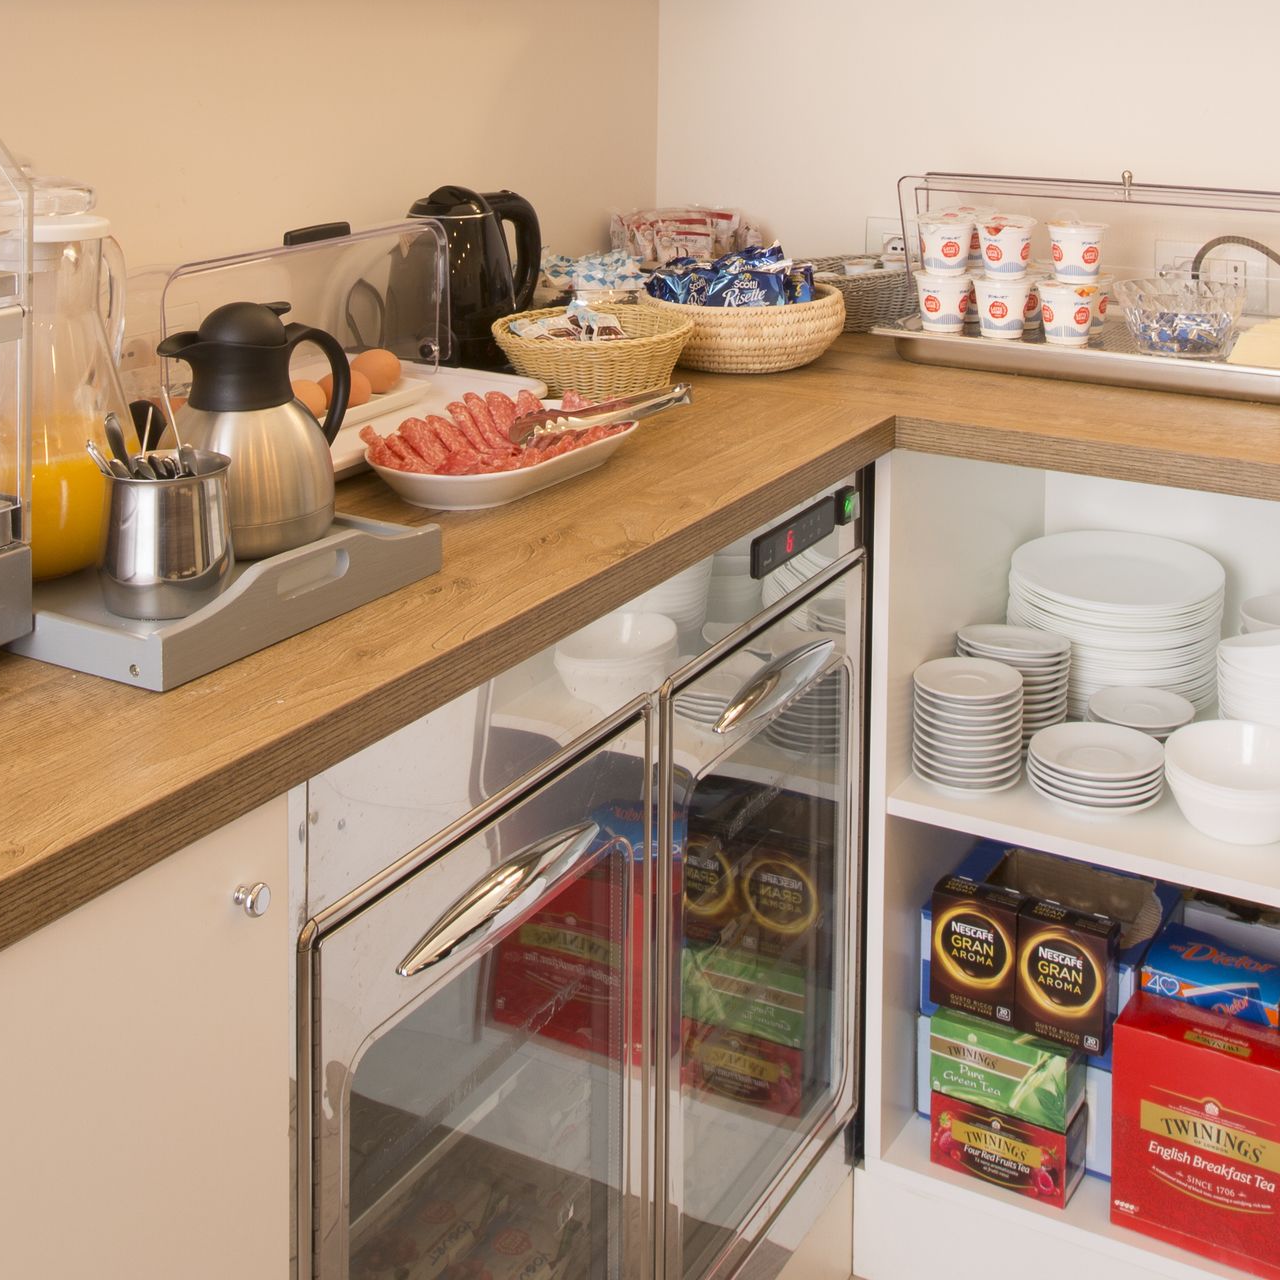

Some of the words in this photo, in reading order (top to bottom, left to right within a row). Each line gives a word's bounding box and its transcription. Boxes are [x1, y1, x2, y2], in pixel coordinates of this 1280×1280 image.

[722, 289, 766, 307] Risette
[785, 529, 795, 553] 6
[951, 935, 994, 957] GRAN
[951, 949, 994, 967] AROMA
[1180, 942, 1279, 974] Dietor
[1038, 960, 1083, 985] GRAN
[1038, 975, 1082, 995] AROMA
[950, 993, 971, 1003] GUSTO
[1035, 1021, 1057, 1032] GUSTO
[946, 1045, 998, 1070] TWININGS
[943, 1070, 977, 1088] Green
[979, 1079, 1001, 1096] Tea
[960, 1064, 985, 1080] Pure
[964, 1131, 1028, 1161] TWININGS
[1160, 1117, 1264, 1164] TWININGS
[963, 1144, 981, 1155] Four
[981, 1150, 996, 1162] Red
[995, 1155, 1017, 1169] Fruits
[1017, 1163, 1031, 1174] Tea
[1148, 1140, 1191, 1165] English
[1192, 1154, 1251, 1185] Breakfast
[1254, 1174, 1276, 1193] Tea
[1186, 1175, 1213, 1191] SINCE
[1216, 1186, 1235, 1197] 1706
